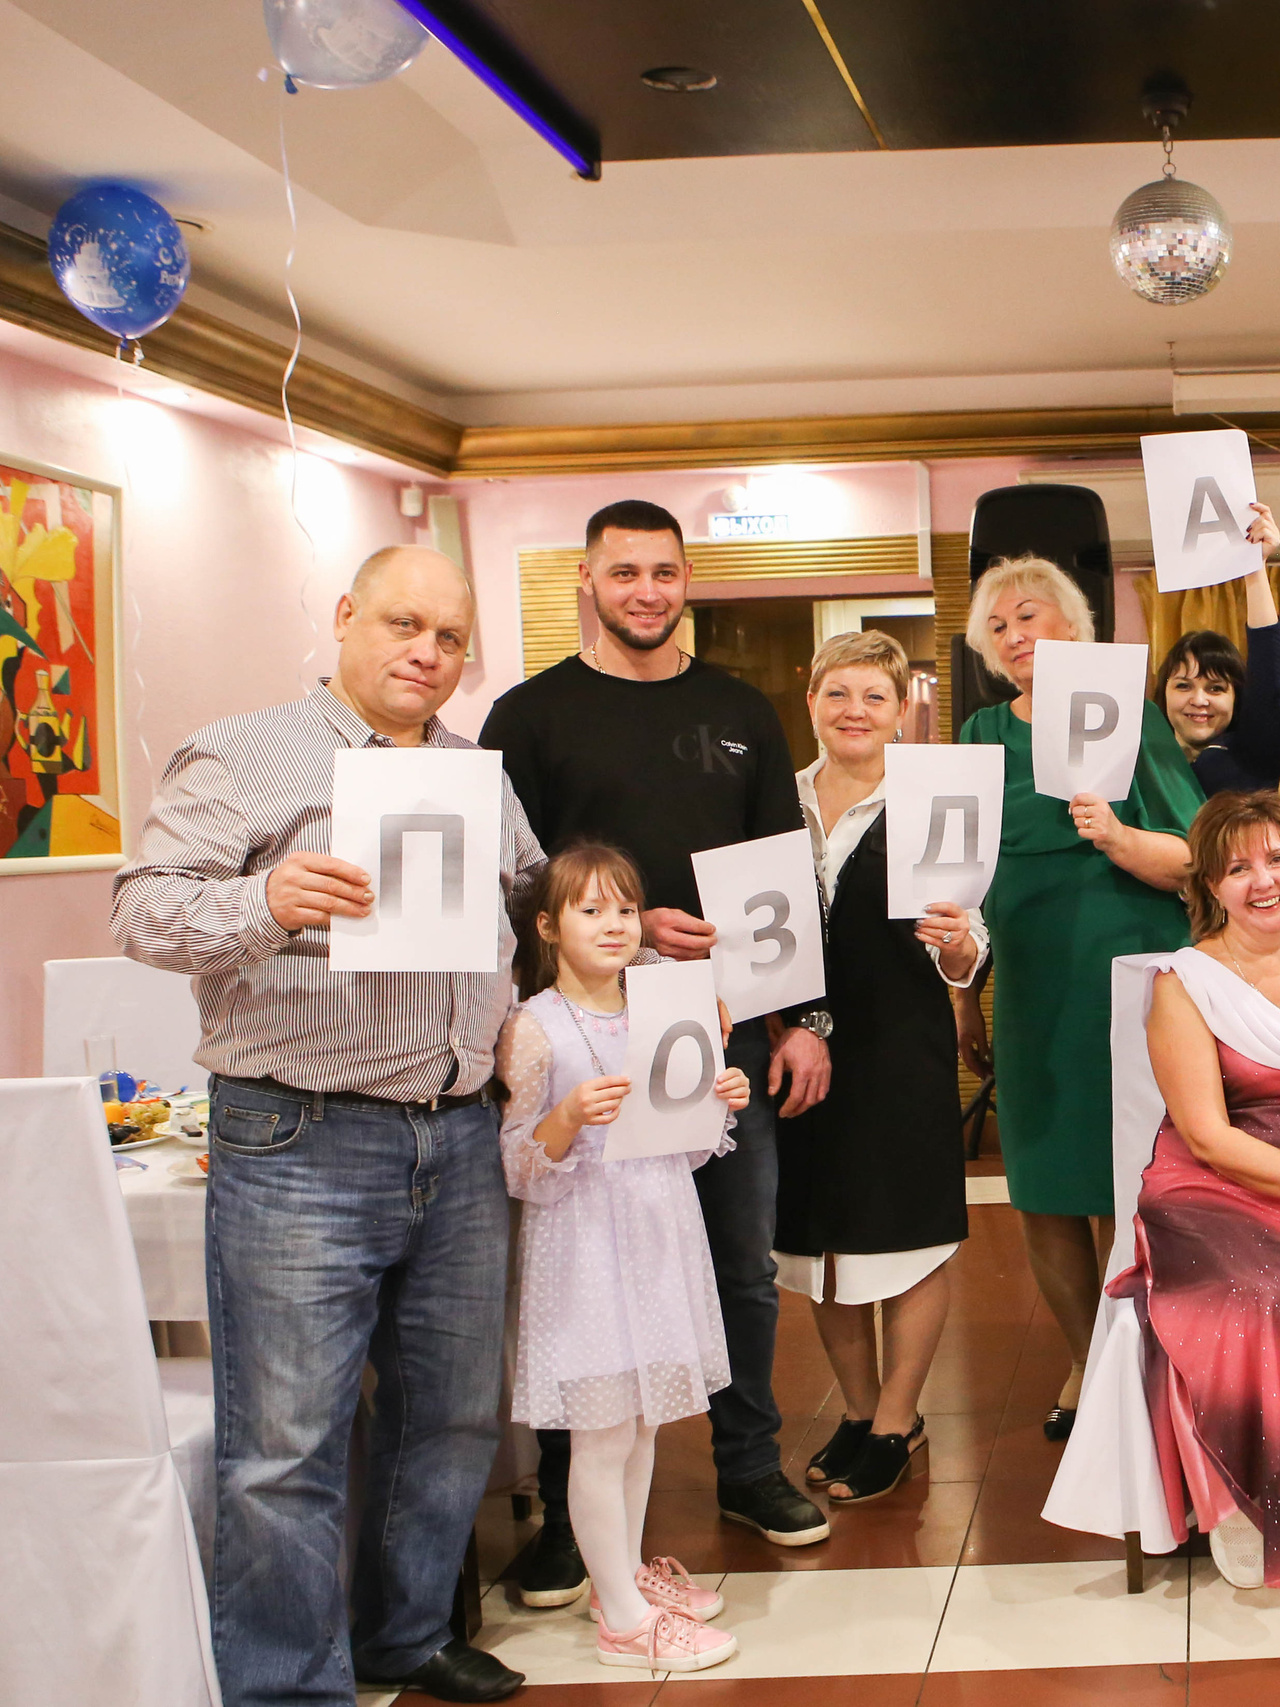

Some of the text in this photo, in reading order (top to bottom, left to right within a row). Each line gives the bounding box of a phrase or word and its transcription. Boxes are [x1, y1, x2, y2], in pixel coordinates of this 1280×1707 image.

[1181, 475, 1248, 556] А
[720, 739, 737, 748] Calvin
[728, 746, 744, 755] Jeans
[1067, 690, 1120, 769] Р
[379, 813, 465, 920] П
[912, 795, 985, 885] Д
[743, 889, 797, 978] З
[647, 1019, 717, 1115] О
